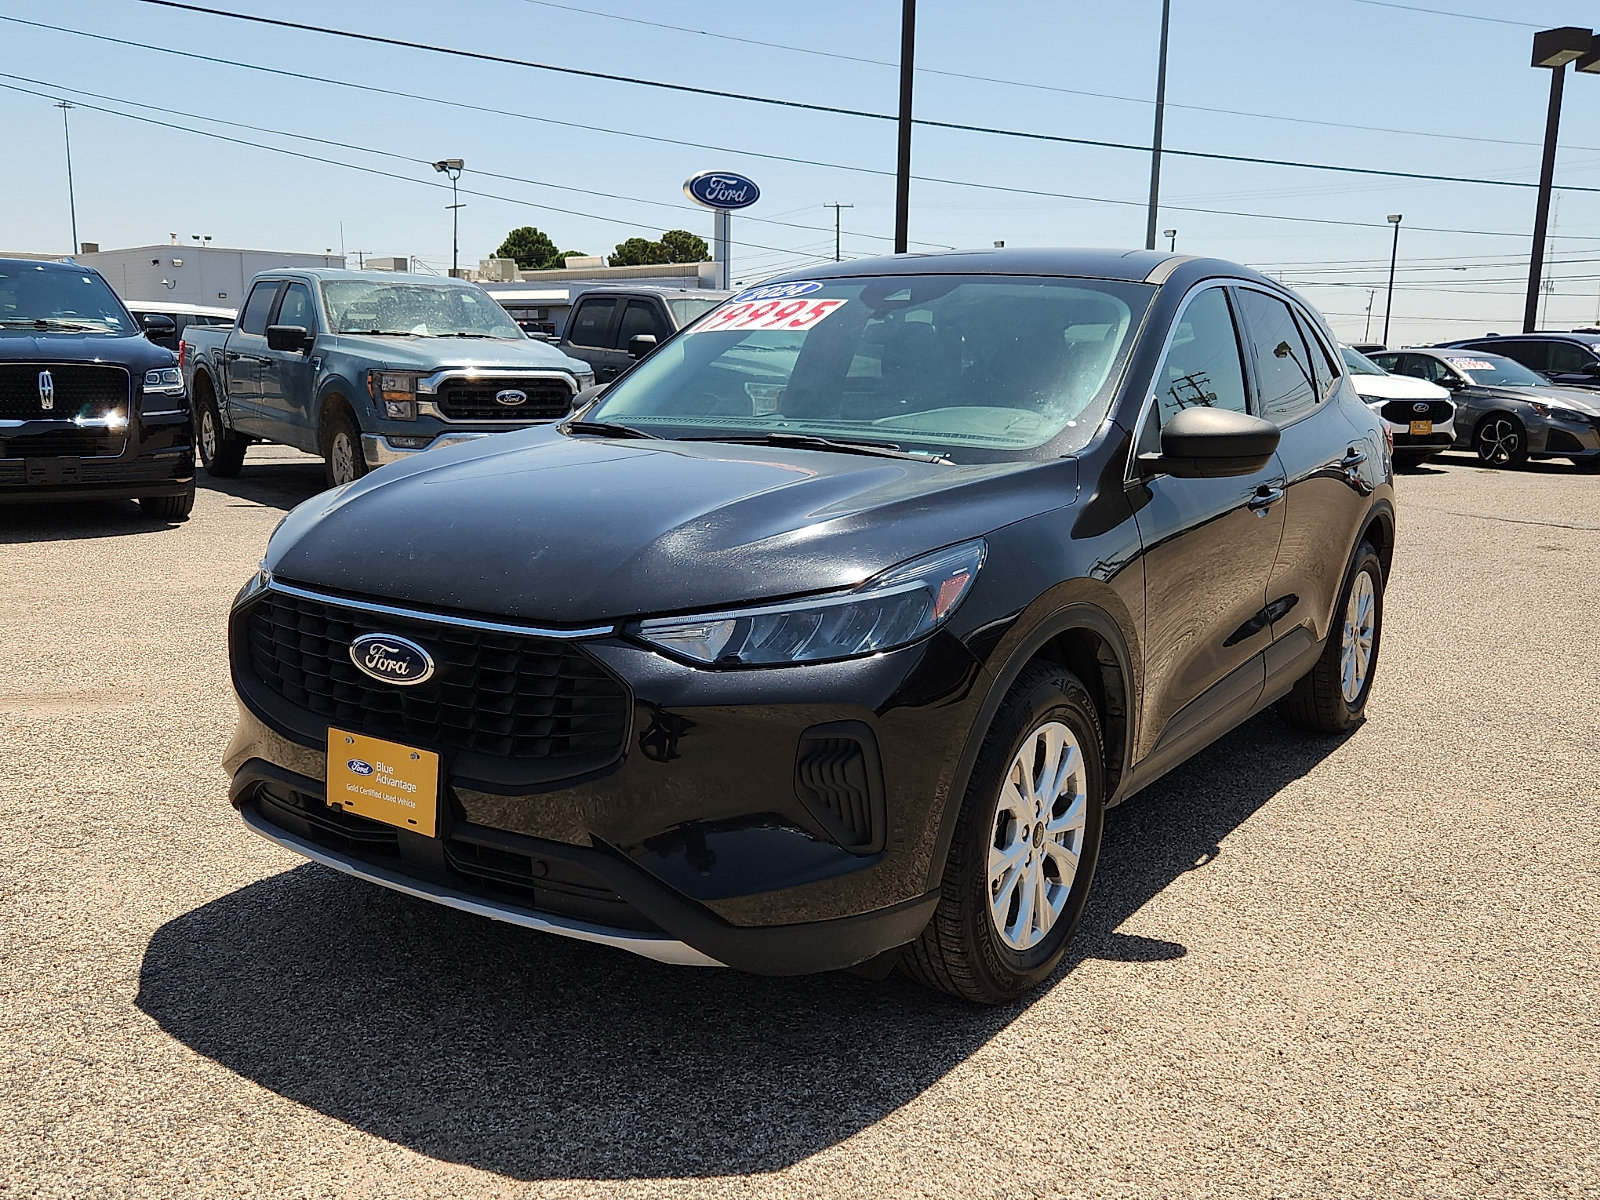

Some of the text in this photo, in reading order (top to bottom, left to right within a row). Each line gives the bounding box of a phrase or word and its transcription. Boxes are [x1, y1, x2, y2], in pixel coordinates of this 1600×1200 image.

[705, 176, 748, 202] Ford
[739, 282, 813, 302] 2024
[693, 299, 843, 332] 19995
[365, 643, 411, 675] Ford
[351, 761, 370, 774] Ford
[376, 761, 394, 775] Blue
[376, 773, 417, 793] Advantage
[346, 783, 416, 809] Gold Certified Used Vehicle
